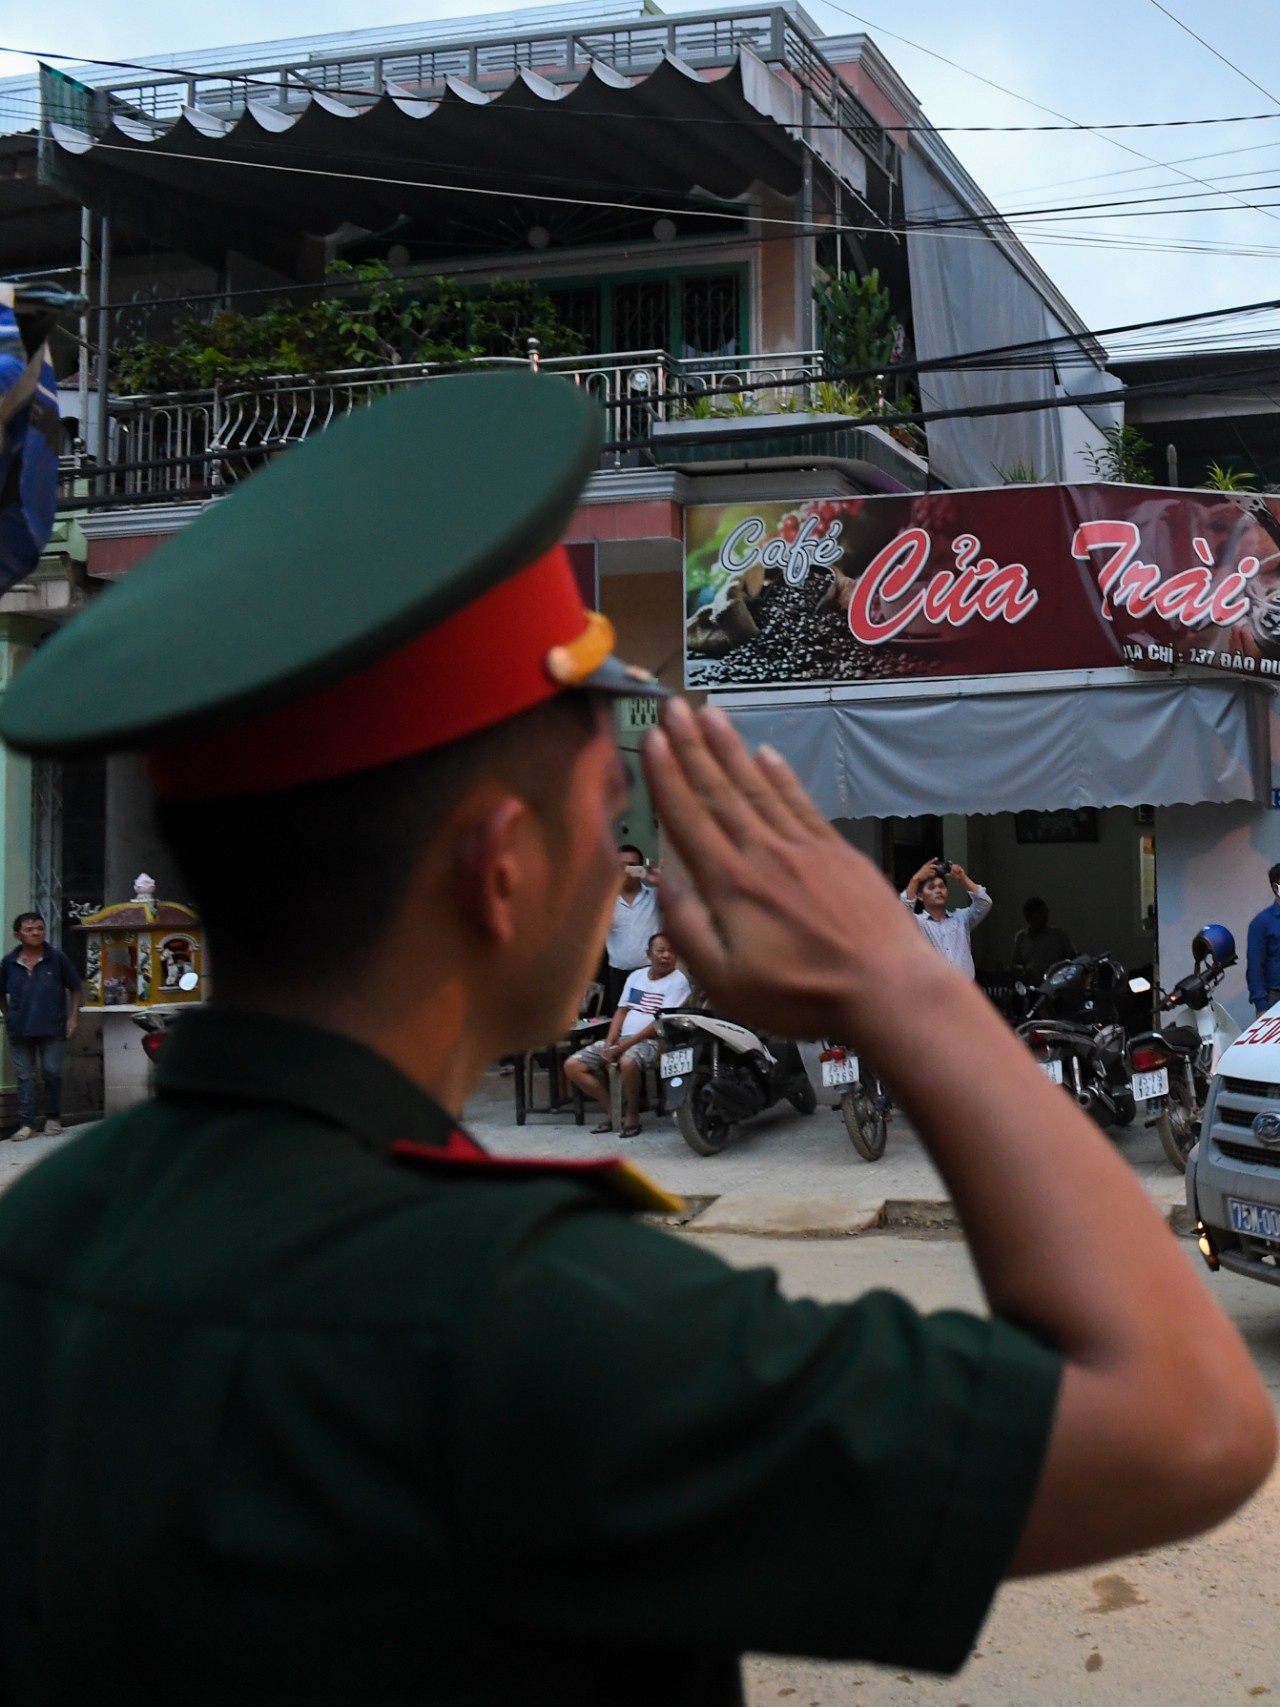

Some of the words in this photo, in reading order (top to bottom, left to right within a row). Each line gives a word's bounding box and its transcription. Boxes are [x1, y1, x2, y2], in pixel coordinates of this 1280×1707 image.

[721, 515, 844, 586] Café
[848, 527, 1038, 645] Cửa
[1071, 520, 1260, 626] Trài
[1190, 648, 1216, 665] 137
[1220, 651, 1255, 671] ĐÀO
